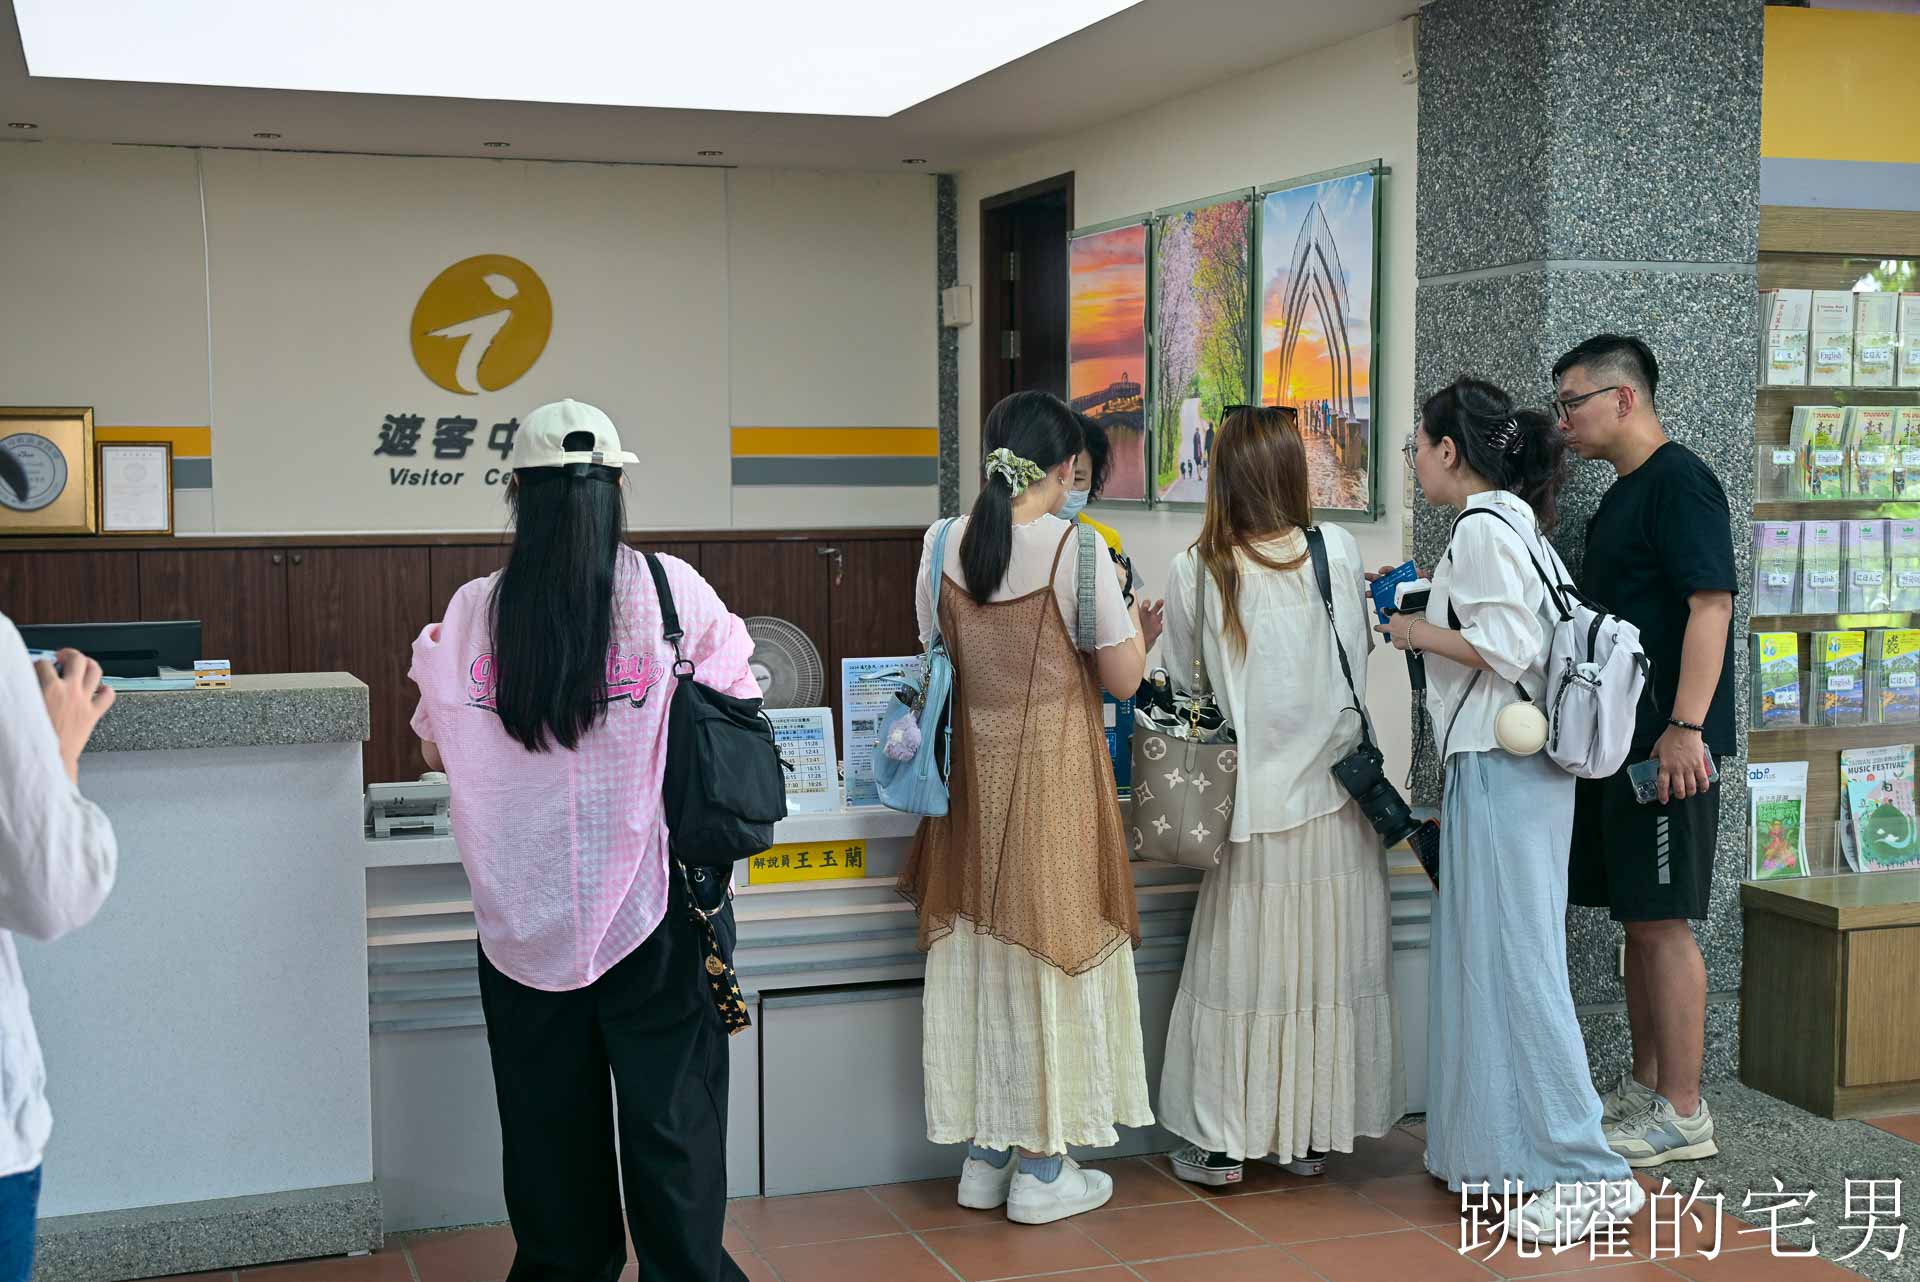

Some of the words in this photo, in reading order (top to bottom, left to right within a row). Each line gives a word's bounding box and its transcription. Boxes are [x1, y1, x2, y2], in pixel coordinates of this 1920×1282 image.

[390, 467, 464, 485] Visitor
[1813, 575, 1835, 585] English
[1848, 765, 1871, 774] MUSIC
[1872, 761, 1905, 772] FESTIVAL
[793, 846, 862, 870] 王玉蘭
